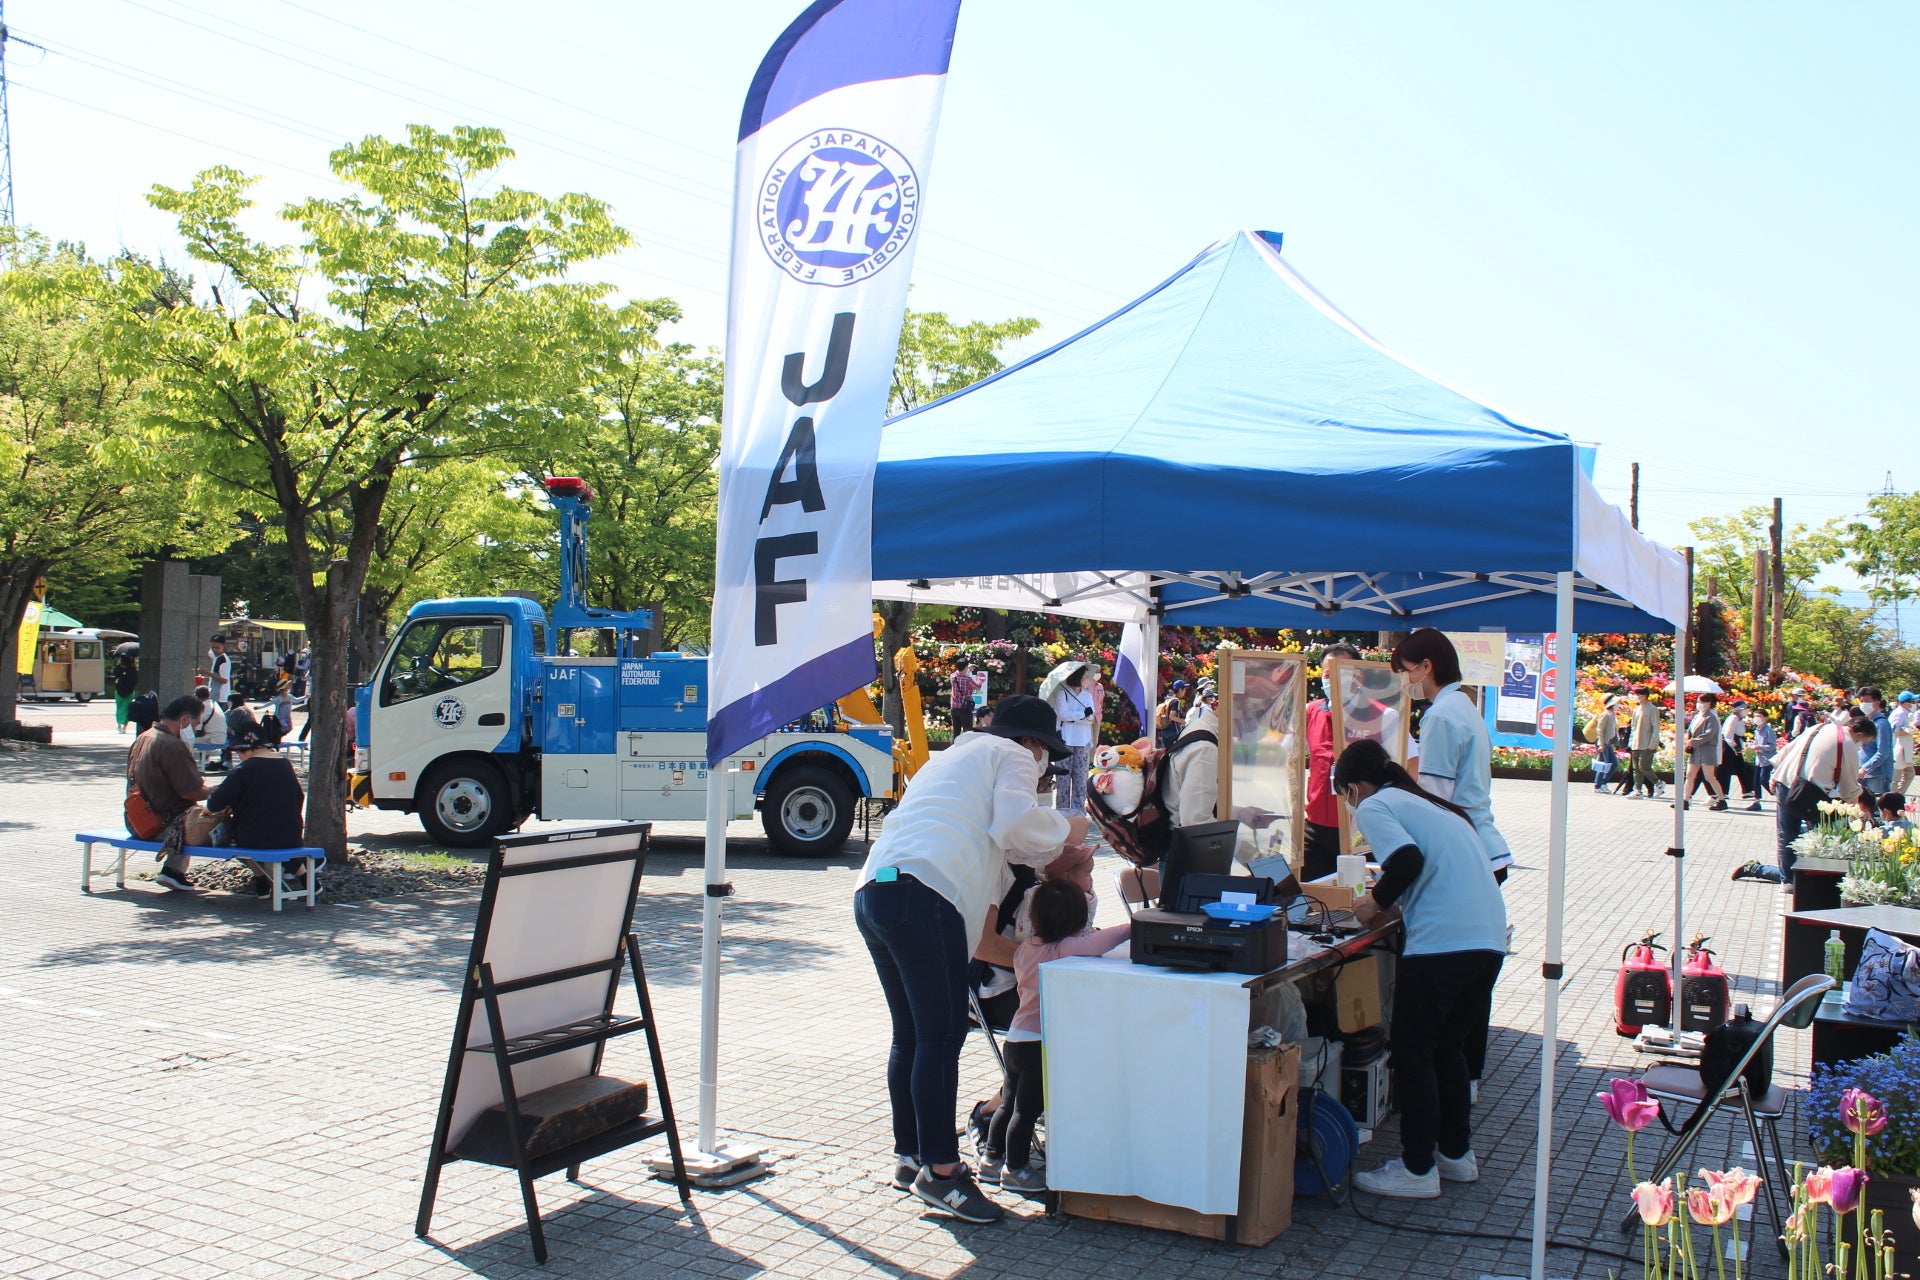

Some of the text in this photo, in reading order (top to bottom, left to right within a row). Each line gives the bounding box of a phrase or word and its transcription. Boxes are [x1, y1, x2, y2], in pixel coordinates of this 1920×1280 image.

[761, 133, 916, 282] JAPAN AUTOMOBILE FEDERATION
[754, 311, 857, 647] JAF
[621, 662, 643, 671] JAPAN
[549, 668, 577, 680] JAF
[621, 670, 661, 678] AUTOMOBILE
[621, 677, 660, 686] FEDERATION
[942, 1188, 968, 1209] N
